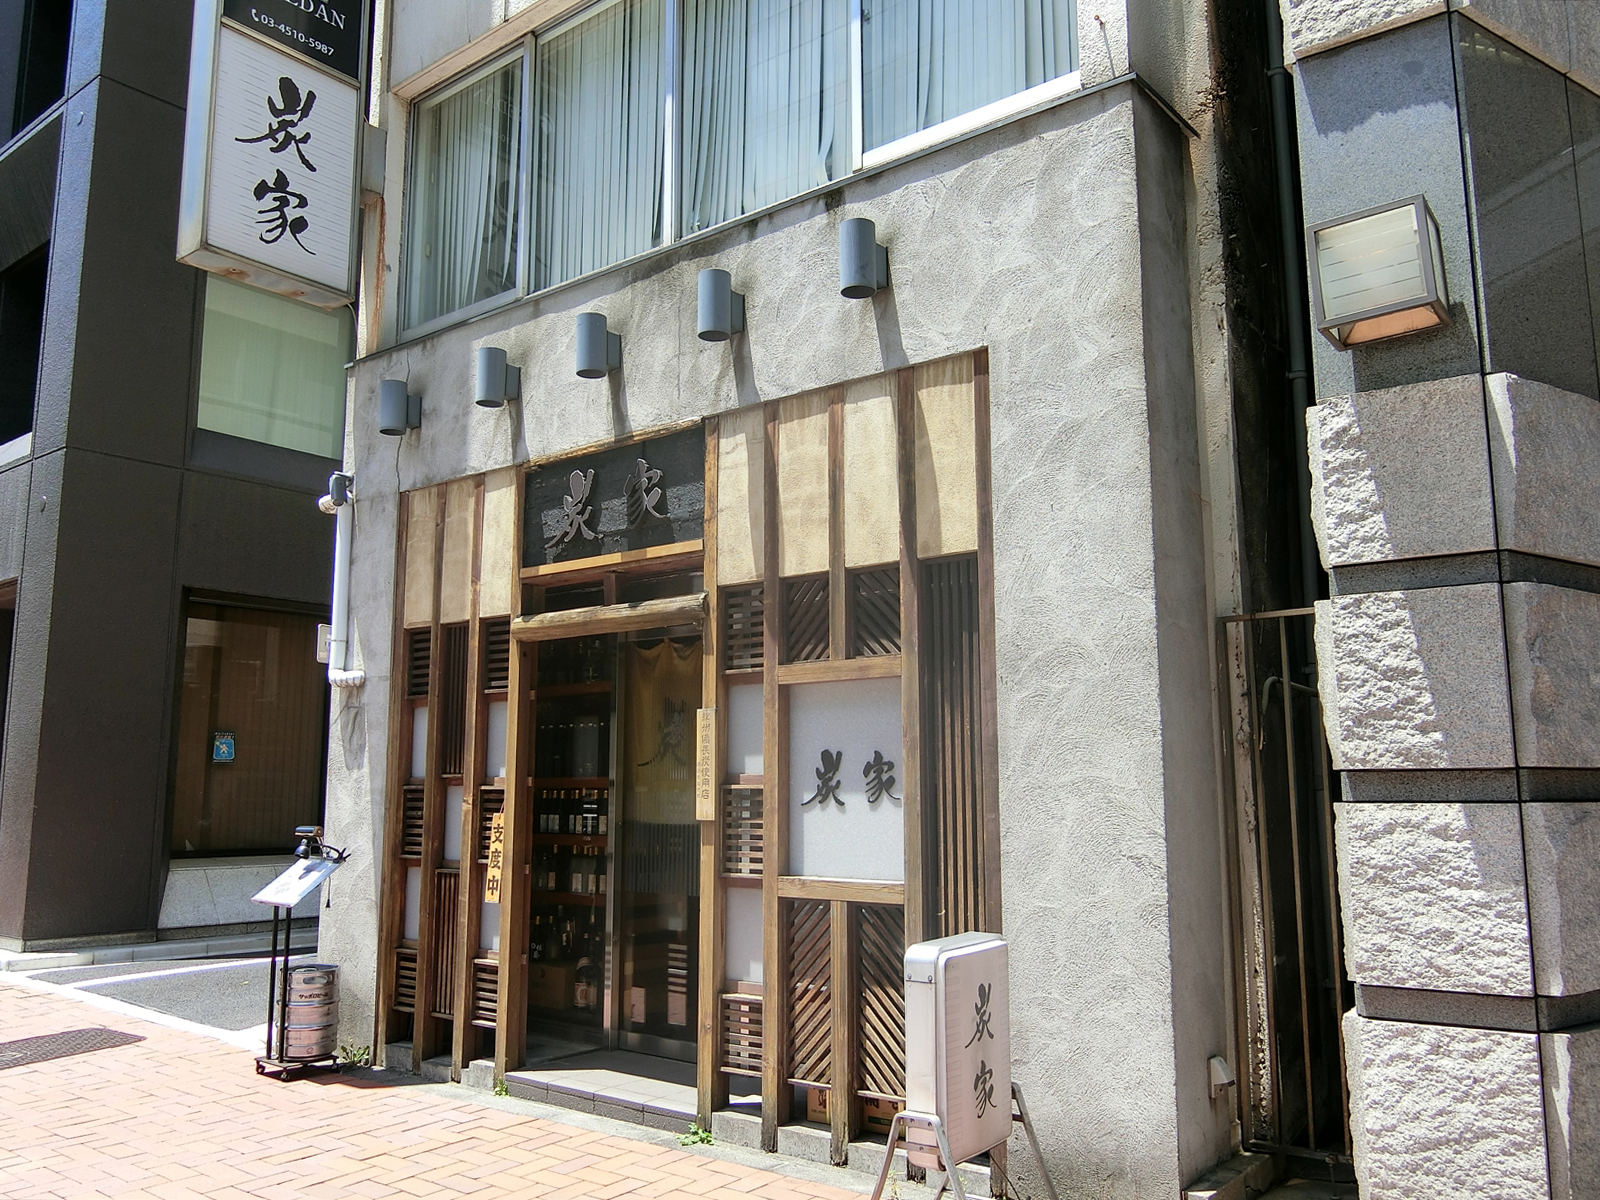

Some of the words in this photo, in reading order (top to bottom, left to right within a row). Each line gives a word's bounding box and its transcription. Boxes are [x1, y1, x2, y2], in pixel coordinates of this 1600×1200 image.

[261, 14, 335, 56] 03-4510-5987
[487, 823, 504, 896] 支度中
